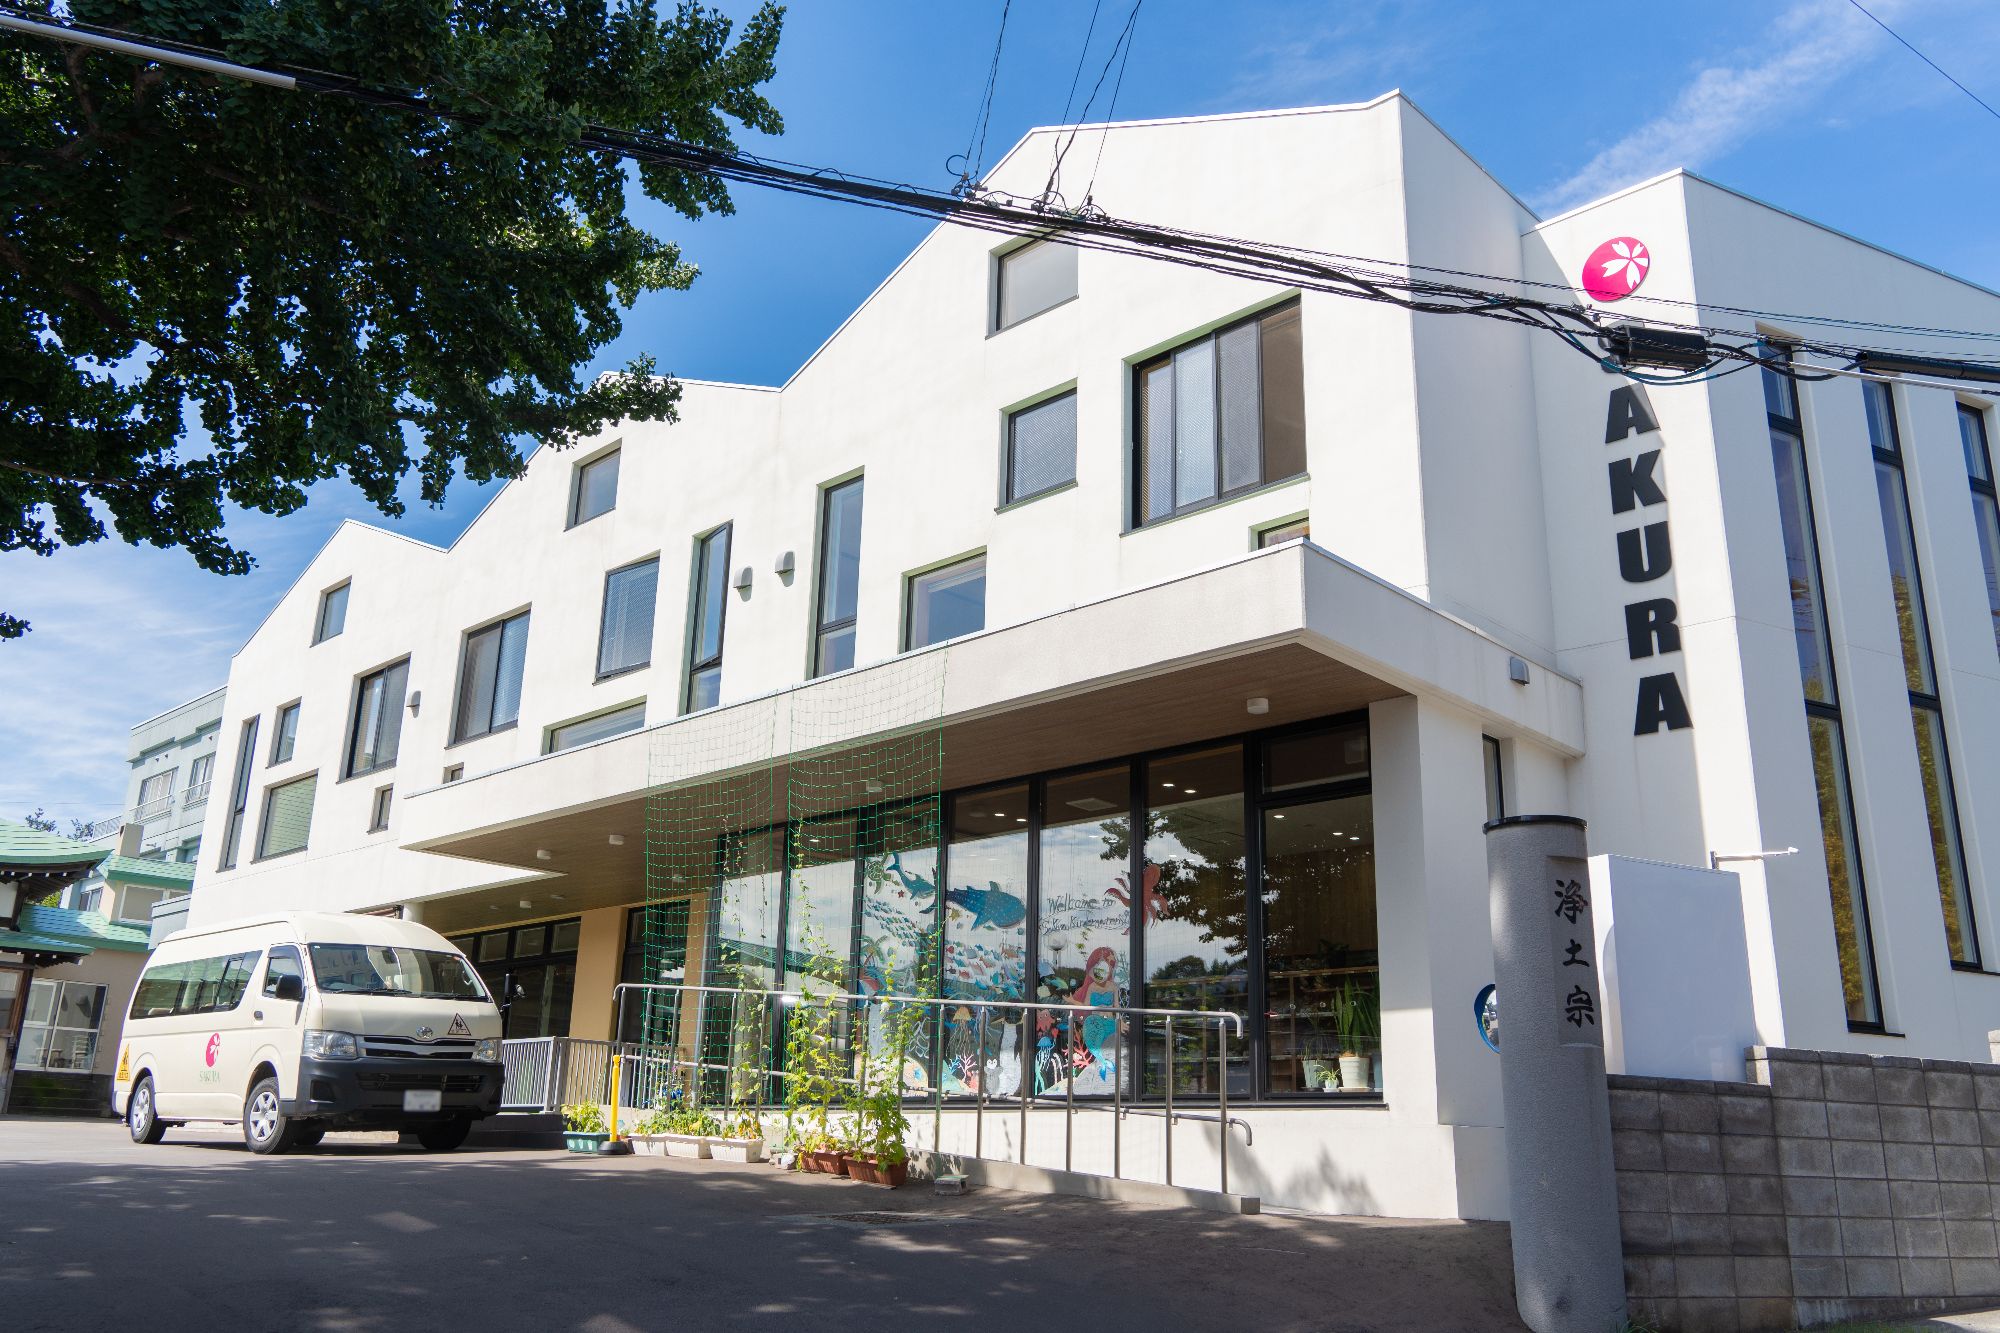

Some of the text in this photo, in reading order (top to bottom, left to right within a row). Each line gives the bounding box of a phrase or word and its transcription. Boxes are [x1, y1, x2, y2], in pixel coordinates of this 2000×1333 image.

[1598, 320, 1693, 735] AKURA
[1047, 892, 1099, 914] Welcome
[1554, 879, 1594, 1028] 浄土宗
